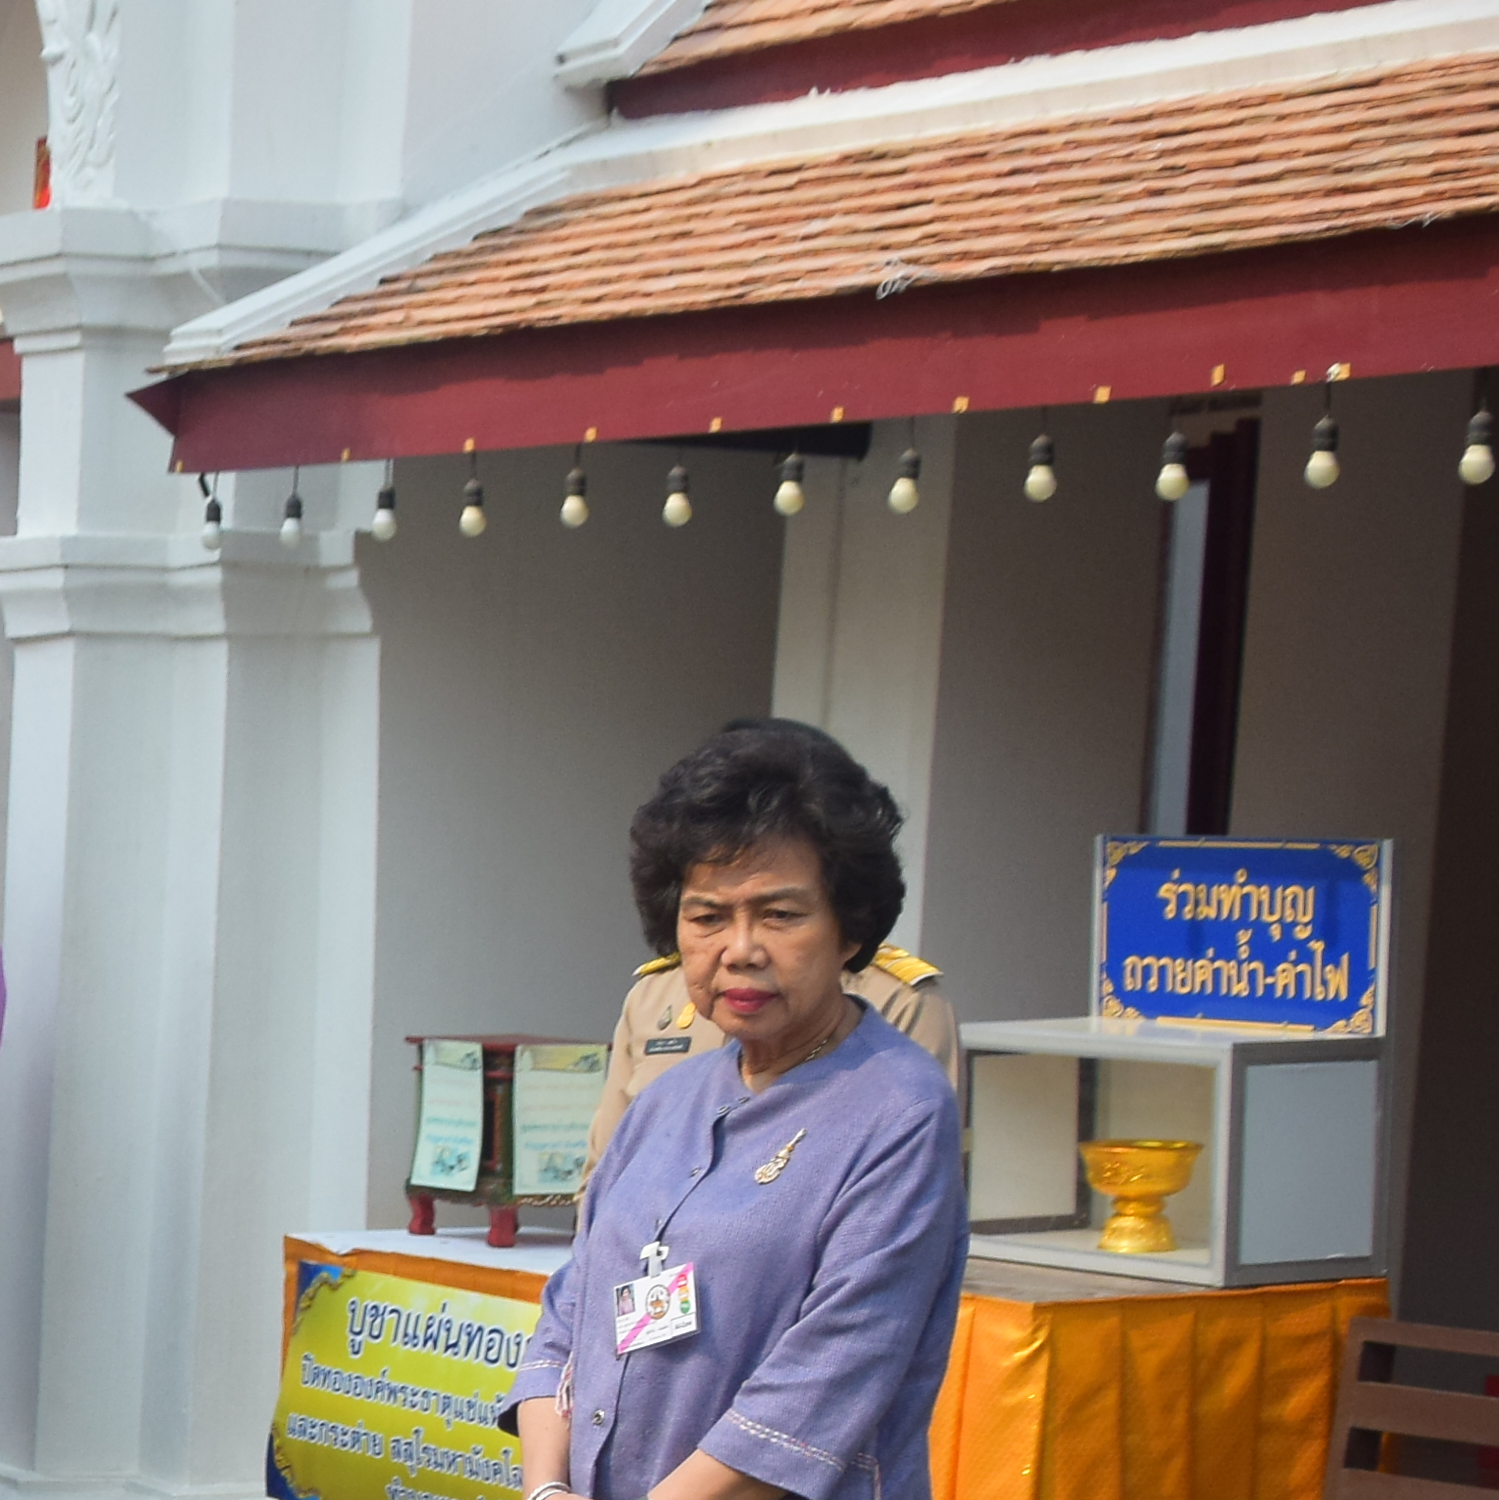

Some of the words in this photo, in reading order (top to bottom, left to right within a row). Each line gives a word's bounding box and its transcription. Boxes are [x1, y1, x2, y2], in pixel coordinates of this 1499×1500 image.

[1157, 868, 1315, 942] ร่วมทำบุญ
[1122, 928, 1349, 1001] ถวายค่าน้ำ-ค่าไฟ
[347, 1298, 530, 1369] บูชาแผ่นทอง
[300, 1354, 505, 1428] ปิดทององค์พระธาตุแช่แห้
[286, 1412, 384, 1457] และกระต่าย
